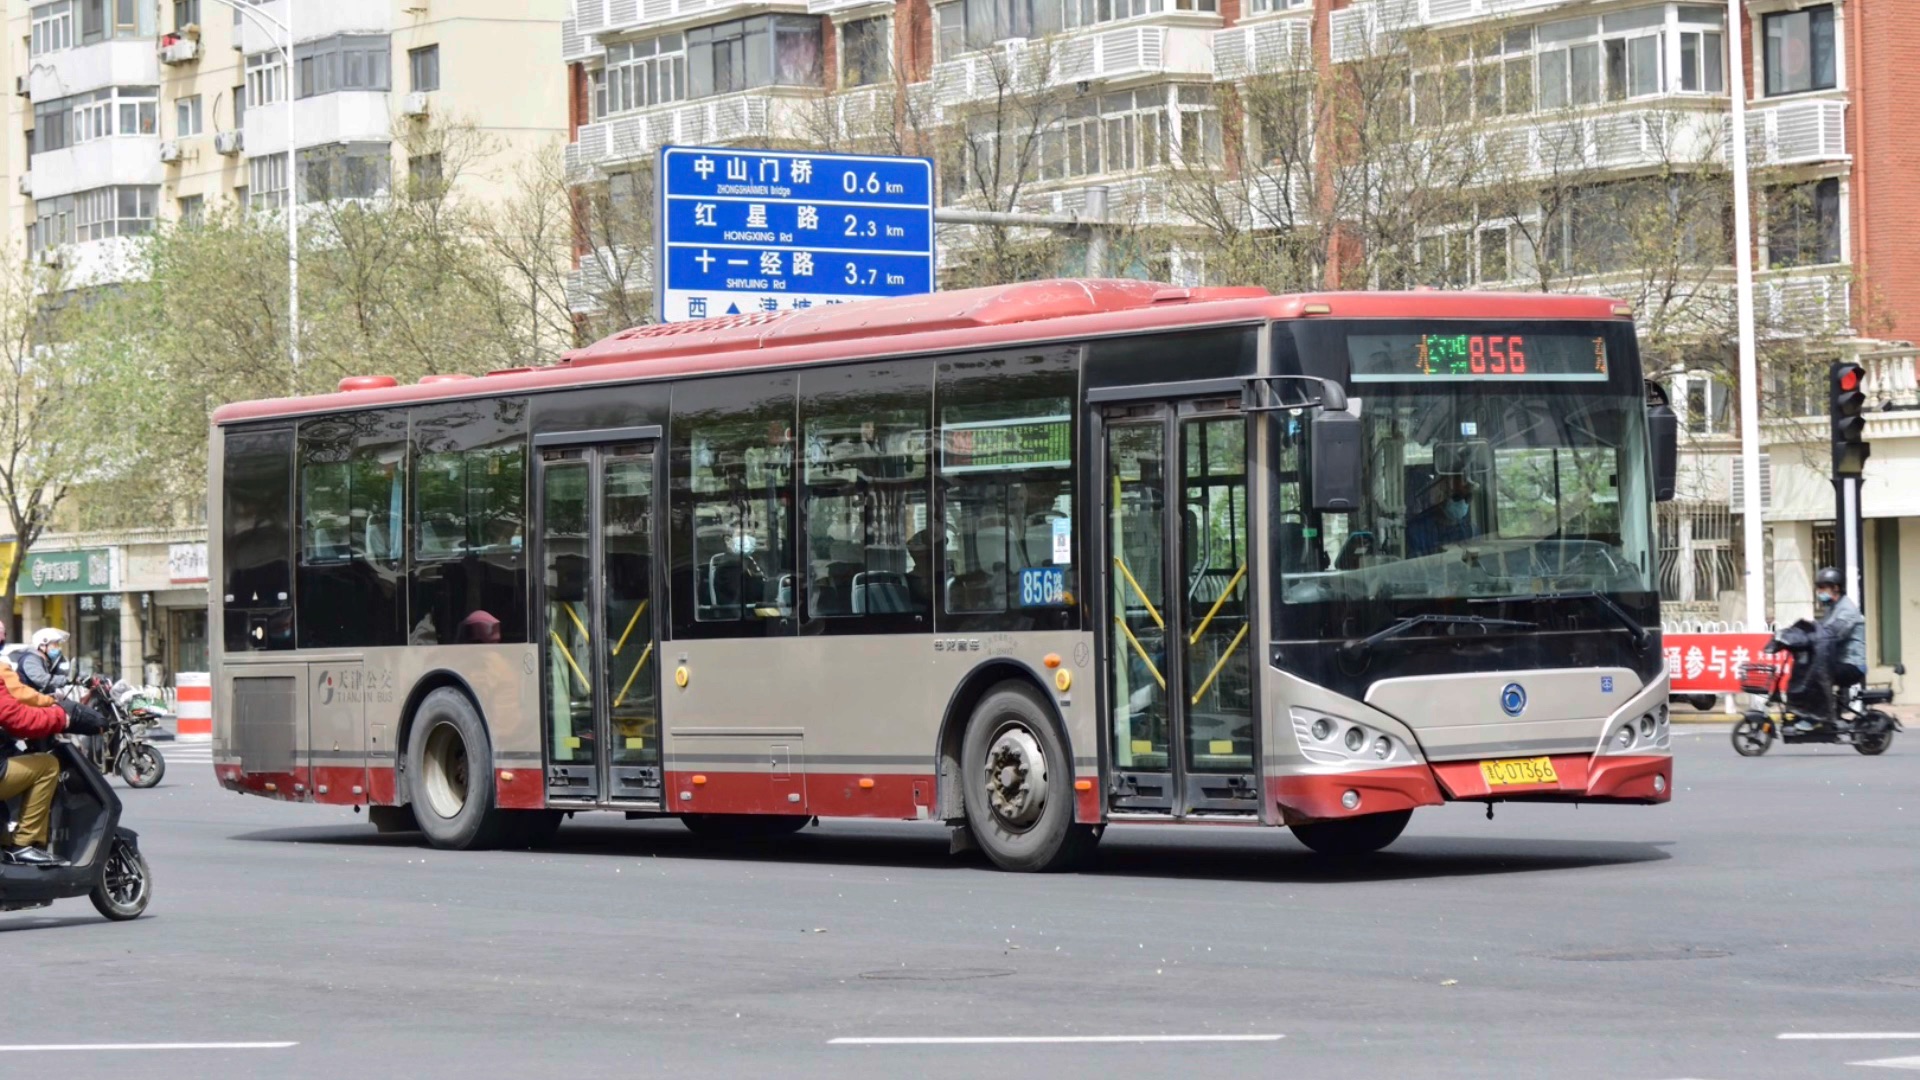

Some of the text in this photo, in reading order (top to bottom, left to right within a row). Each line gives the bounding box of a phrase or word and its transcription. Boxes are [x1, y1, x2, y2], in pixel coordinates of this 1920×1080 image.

[694, 155, 812, 184] 中山门桥
[843, 171, 903, 193] 0.6 km
[695, 202, 819, 230] 红星路
[844, 215, 904, 237] 2.3 km
[724, 231, 792, 242] HONGXING Rd
[695, 249, 814, 276] 十一经路
[773, 280, 786, 290] Rd
[844, 263, 904, 285] 3.7 km
[688, 297, 707, 318] 西
[1469, 336, 1526, 373] 856
[338, 669, 393, 690] 天津公交
[378, 690, 393, 703] BUS
